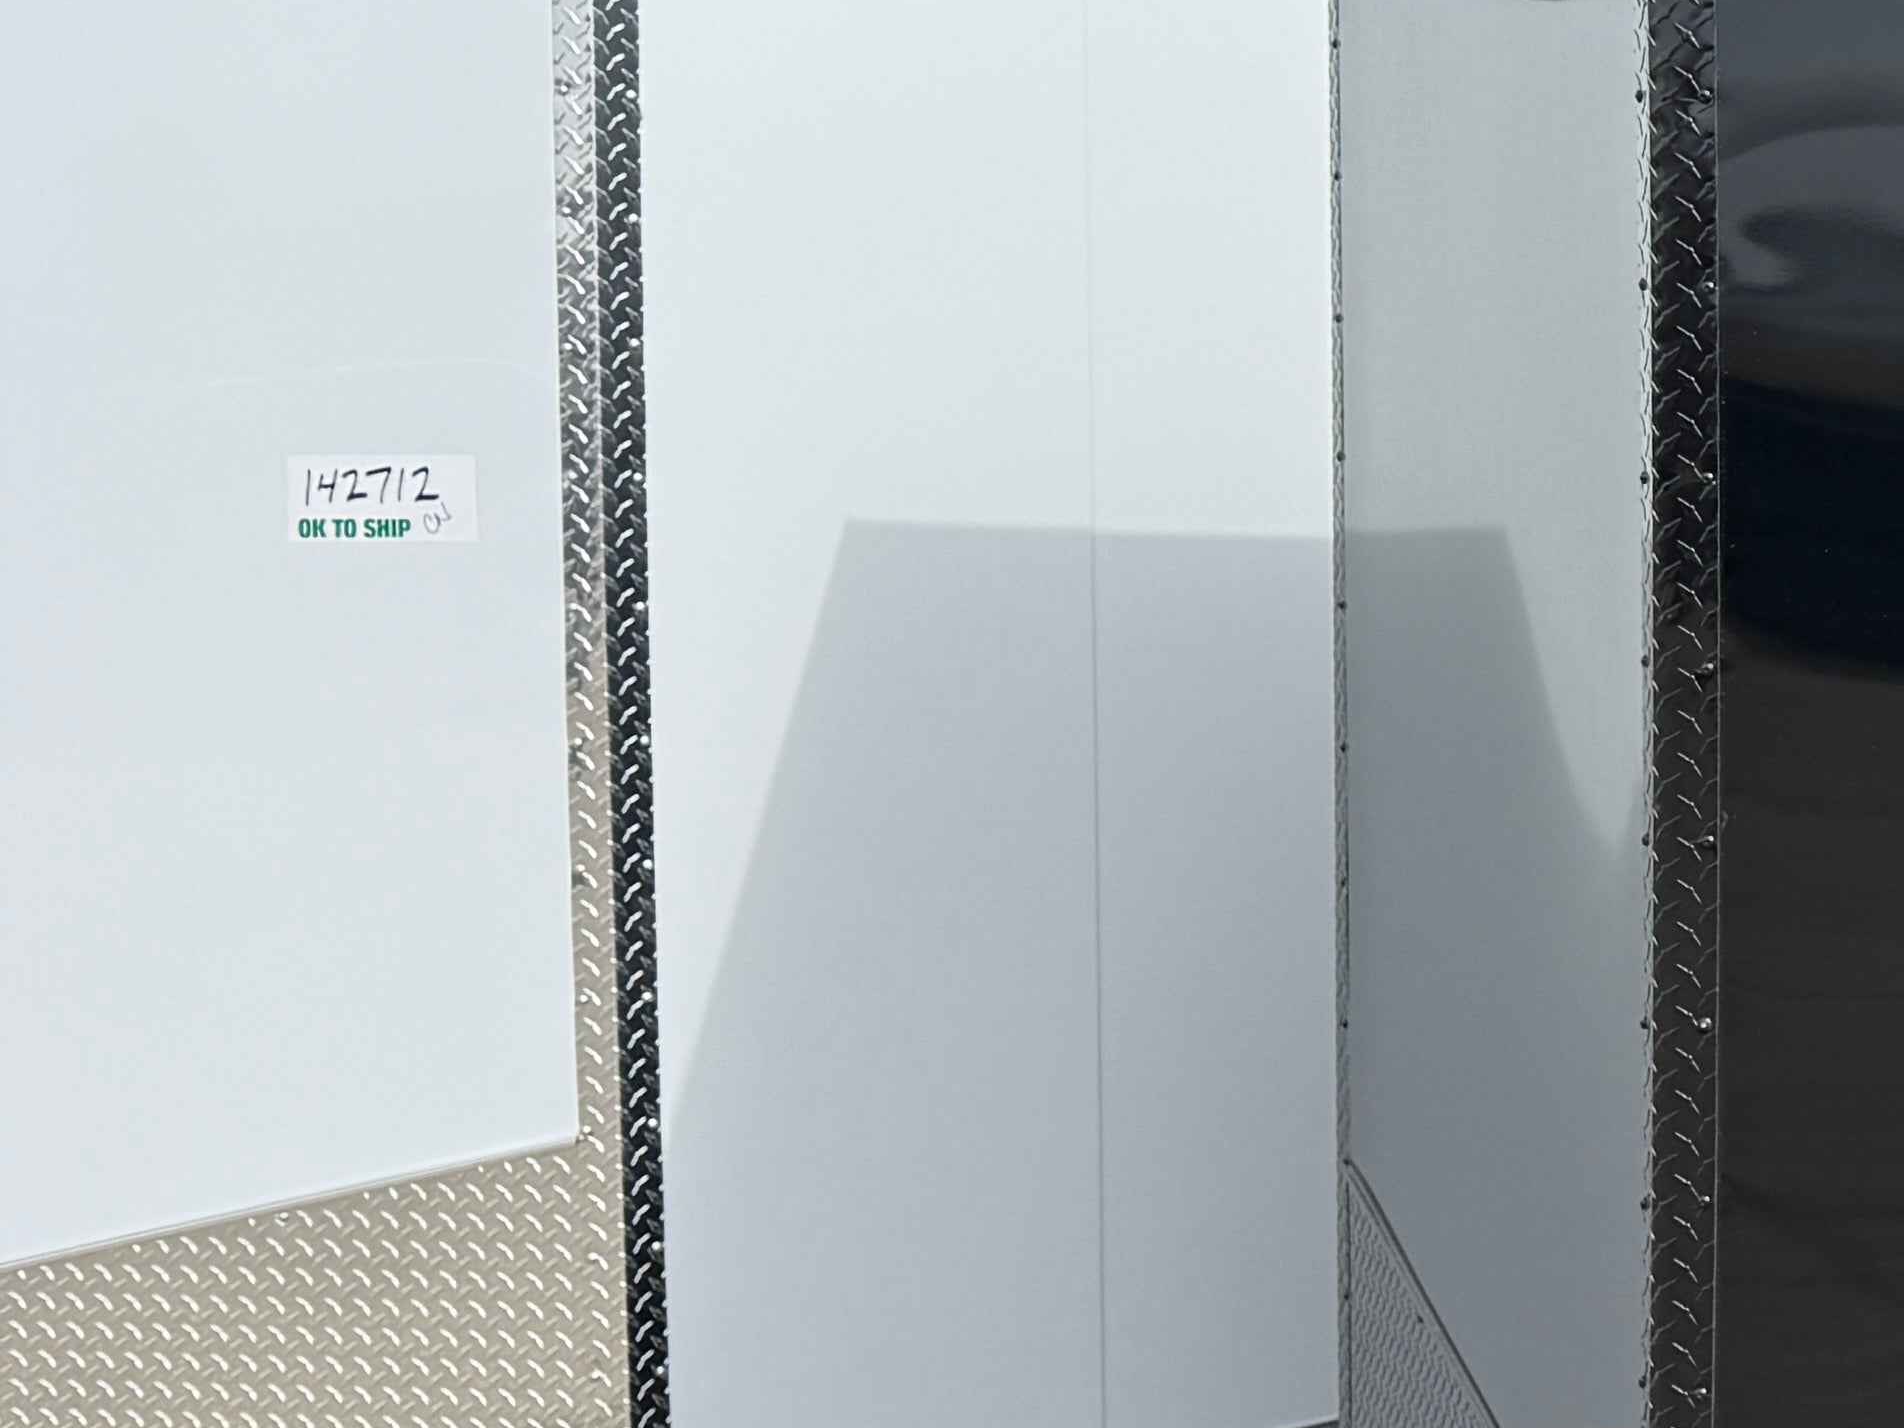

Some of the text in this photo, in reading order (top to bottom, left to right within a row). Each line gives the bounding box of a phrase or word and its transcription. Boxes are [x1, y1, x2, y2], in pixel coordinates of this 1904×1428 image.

[305, 466, 440, 506] 142712
[297, 518, 327, 539] OK
[332, 518, 358, 539] TO
[363, 518, 412, 539] SHIP
